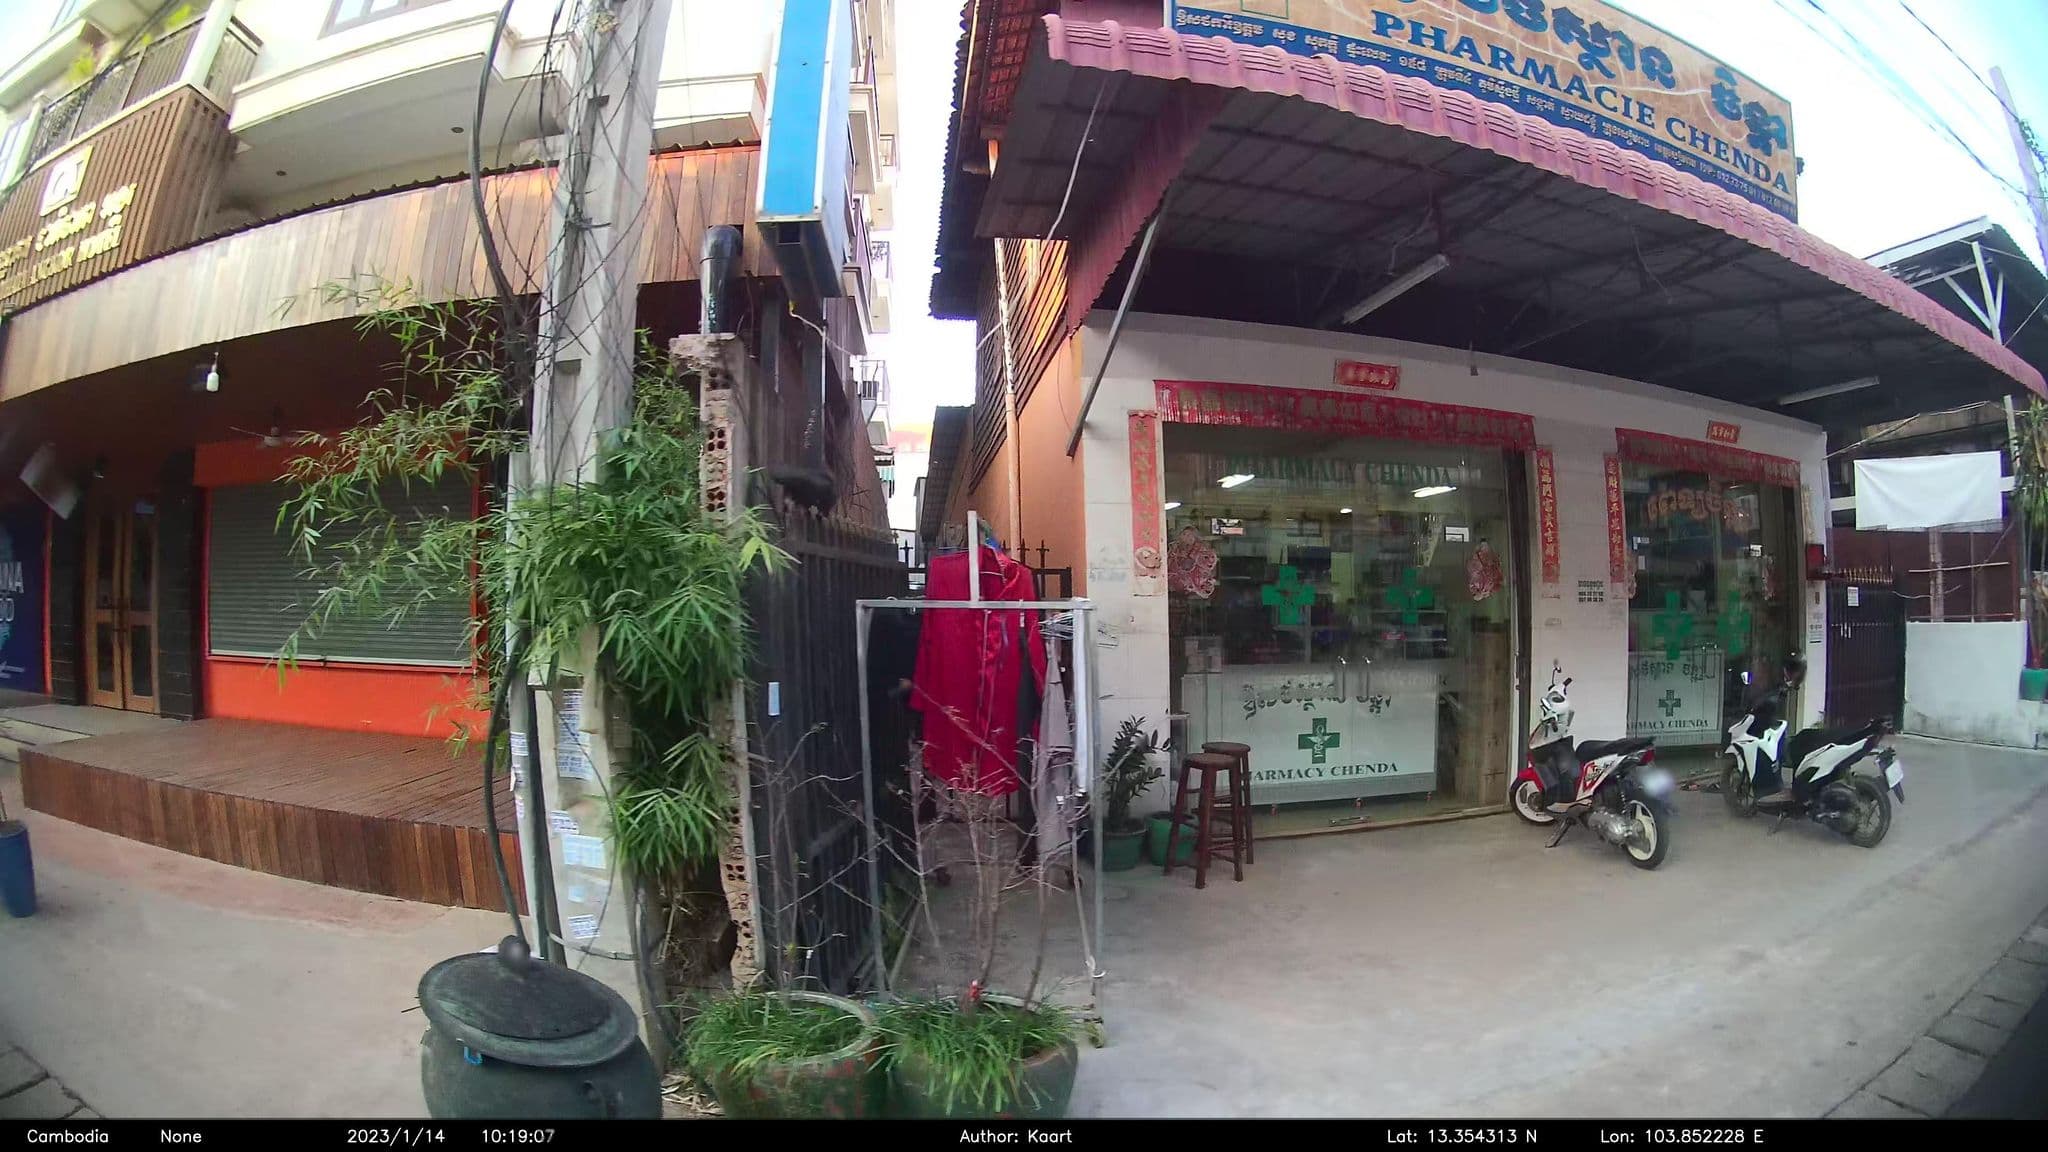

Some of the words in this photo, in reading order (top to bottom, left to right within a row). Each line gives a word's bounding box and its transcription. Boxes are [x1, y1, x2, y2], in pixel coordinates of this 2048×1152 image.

[1371, 9, 1656, 130] PHARMACIE
[1665, 116, 1791, 194] CHENDA
[1330, 762, 1398, 777] CHENDA
